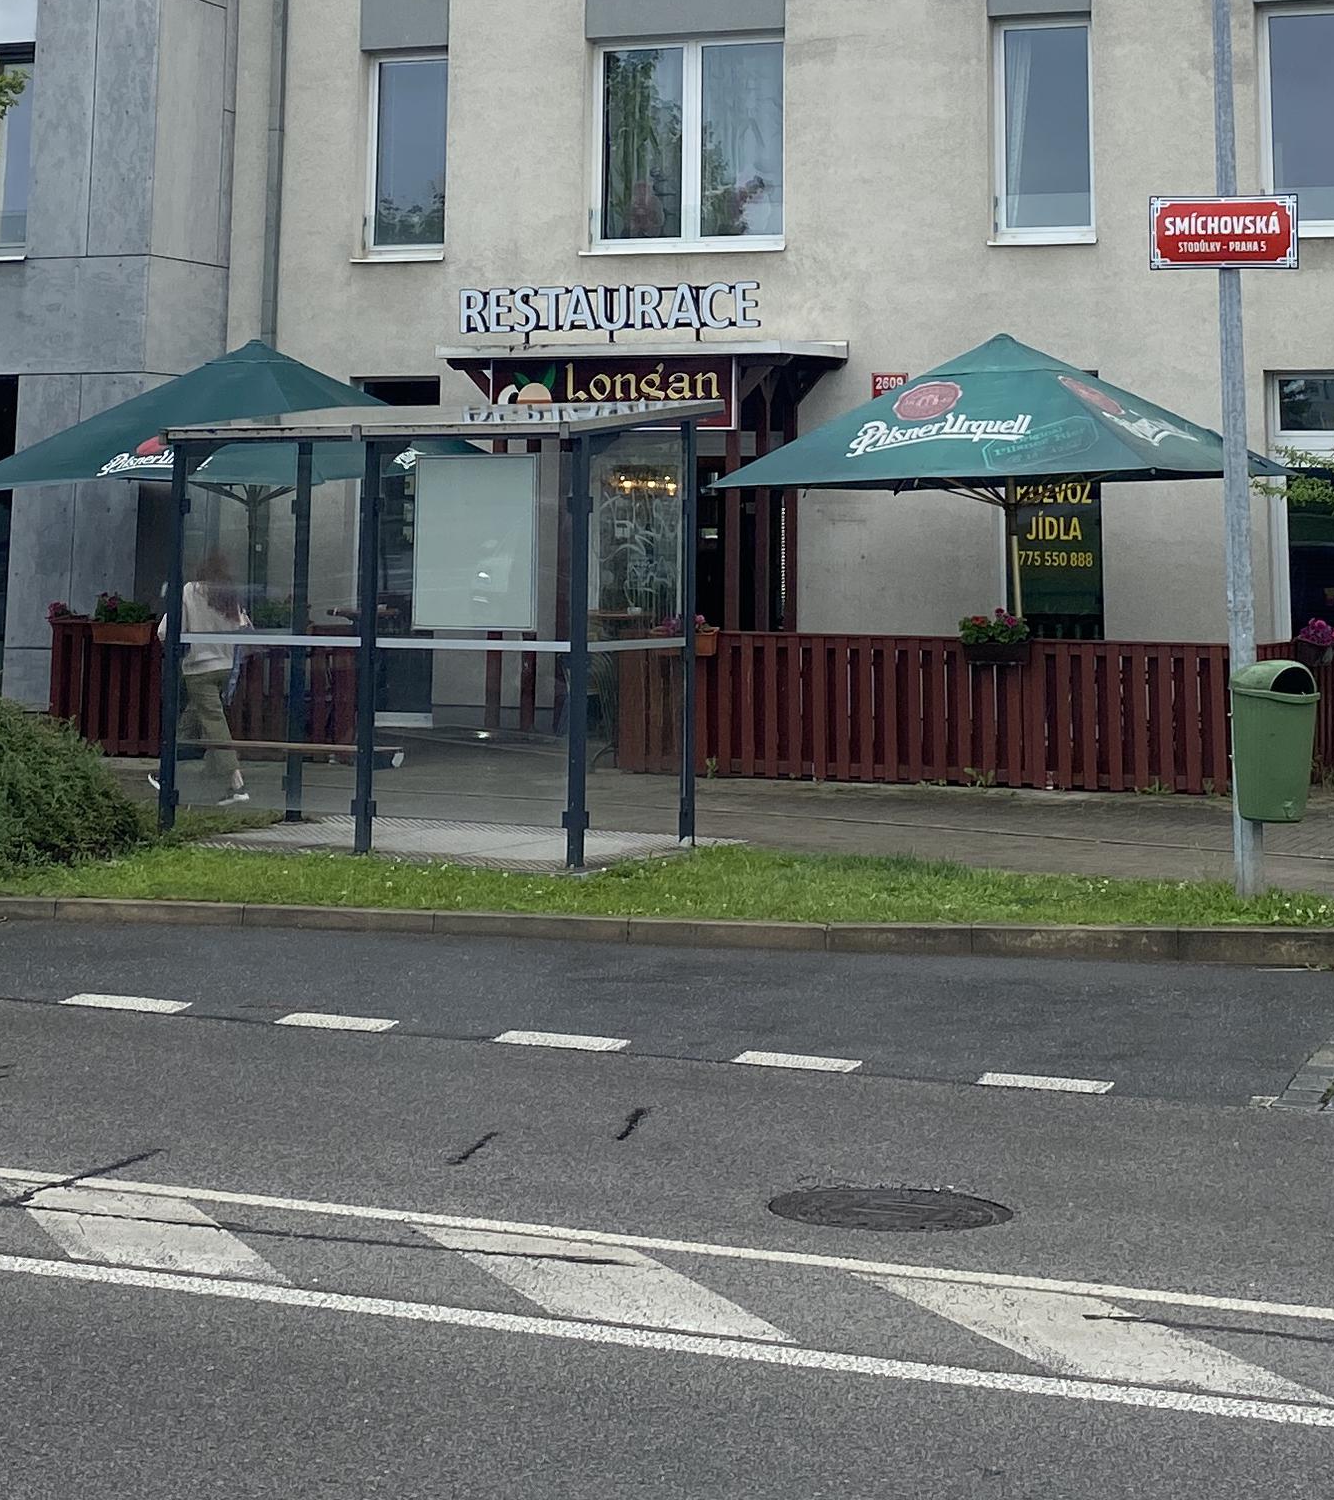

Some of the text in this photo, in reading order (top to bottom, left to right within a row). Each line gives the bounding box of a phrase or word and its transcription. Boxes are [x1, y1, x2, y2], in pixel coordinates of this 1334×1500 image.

[1164, 211, 1281, 236] SMÍCHOVSKÁ
[1178, 239, 1221, 253] STODŮLKY
[1229, 240, 1259, 252] PRAHA
[1260, 240, 1267, 252] 5
[458, 281, 761, 334] RESTAURACE
[566, 361, 720, 402] Longan
[875, 376, 904, 390] 2609
[846, 411, 1033, 457] Pilsner Urquell
[1026, 509, 1082, 541] JÍDLA
[1018, 550, 1094, 568] 775 550 888
